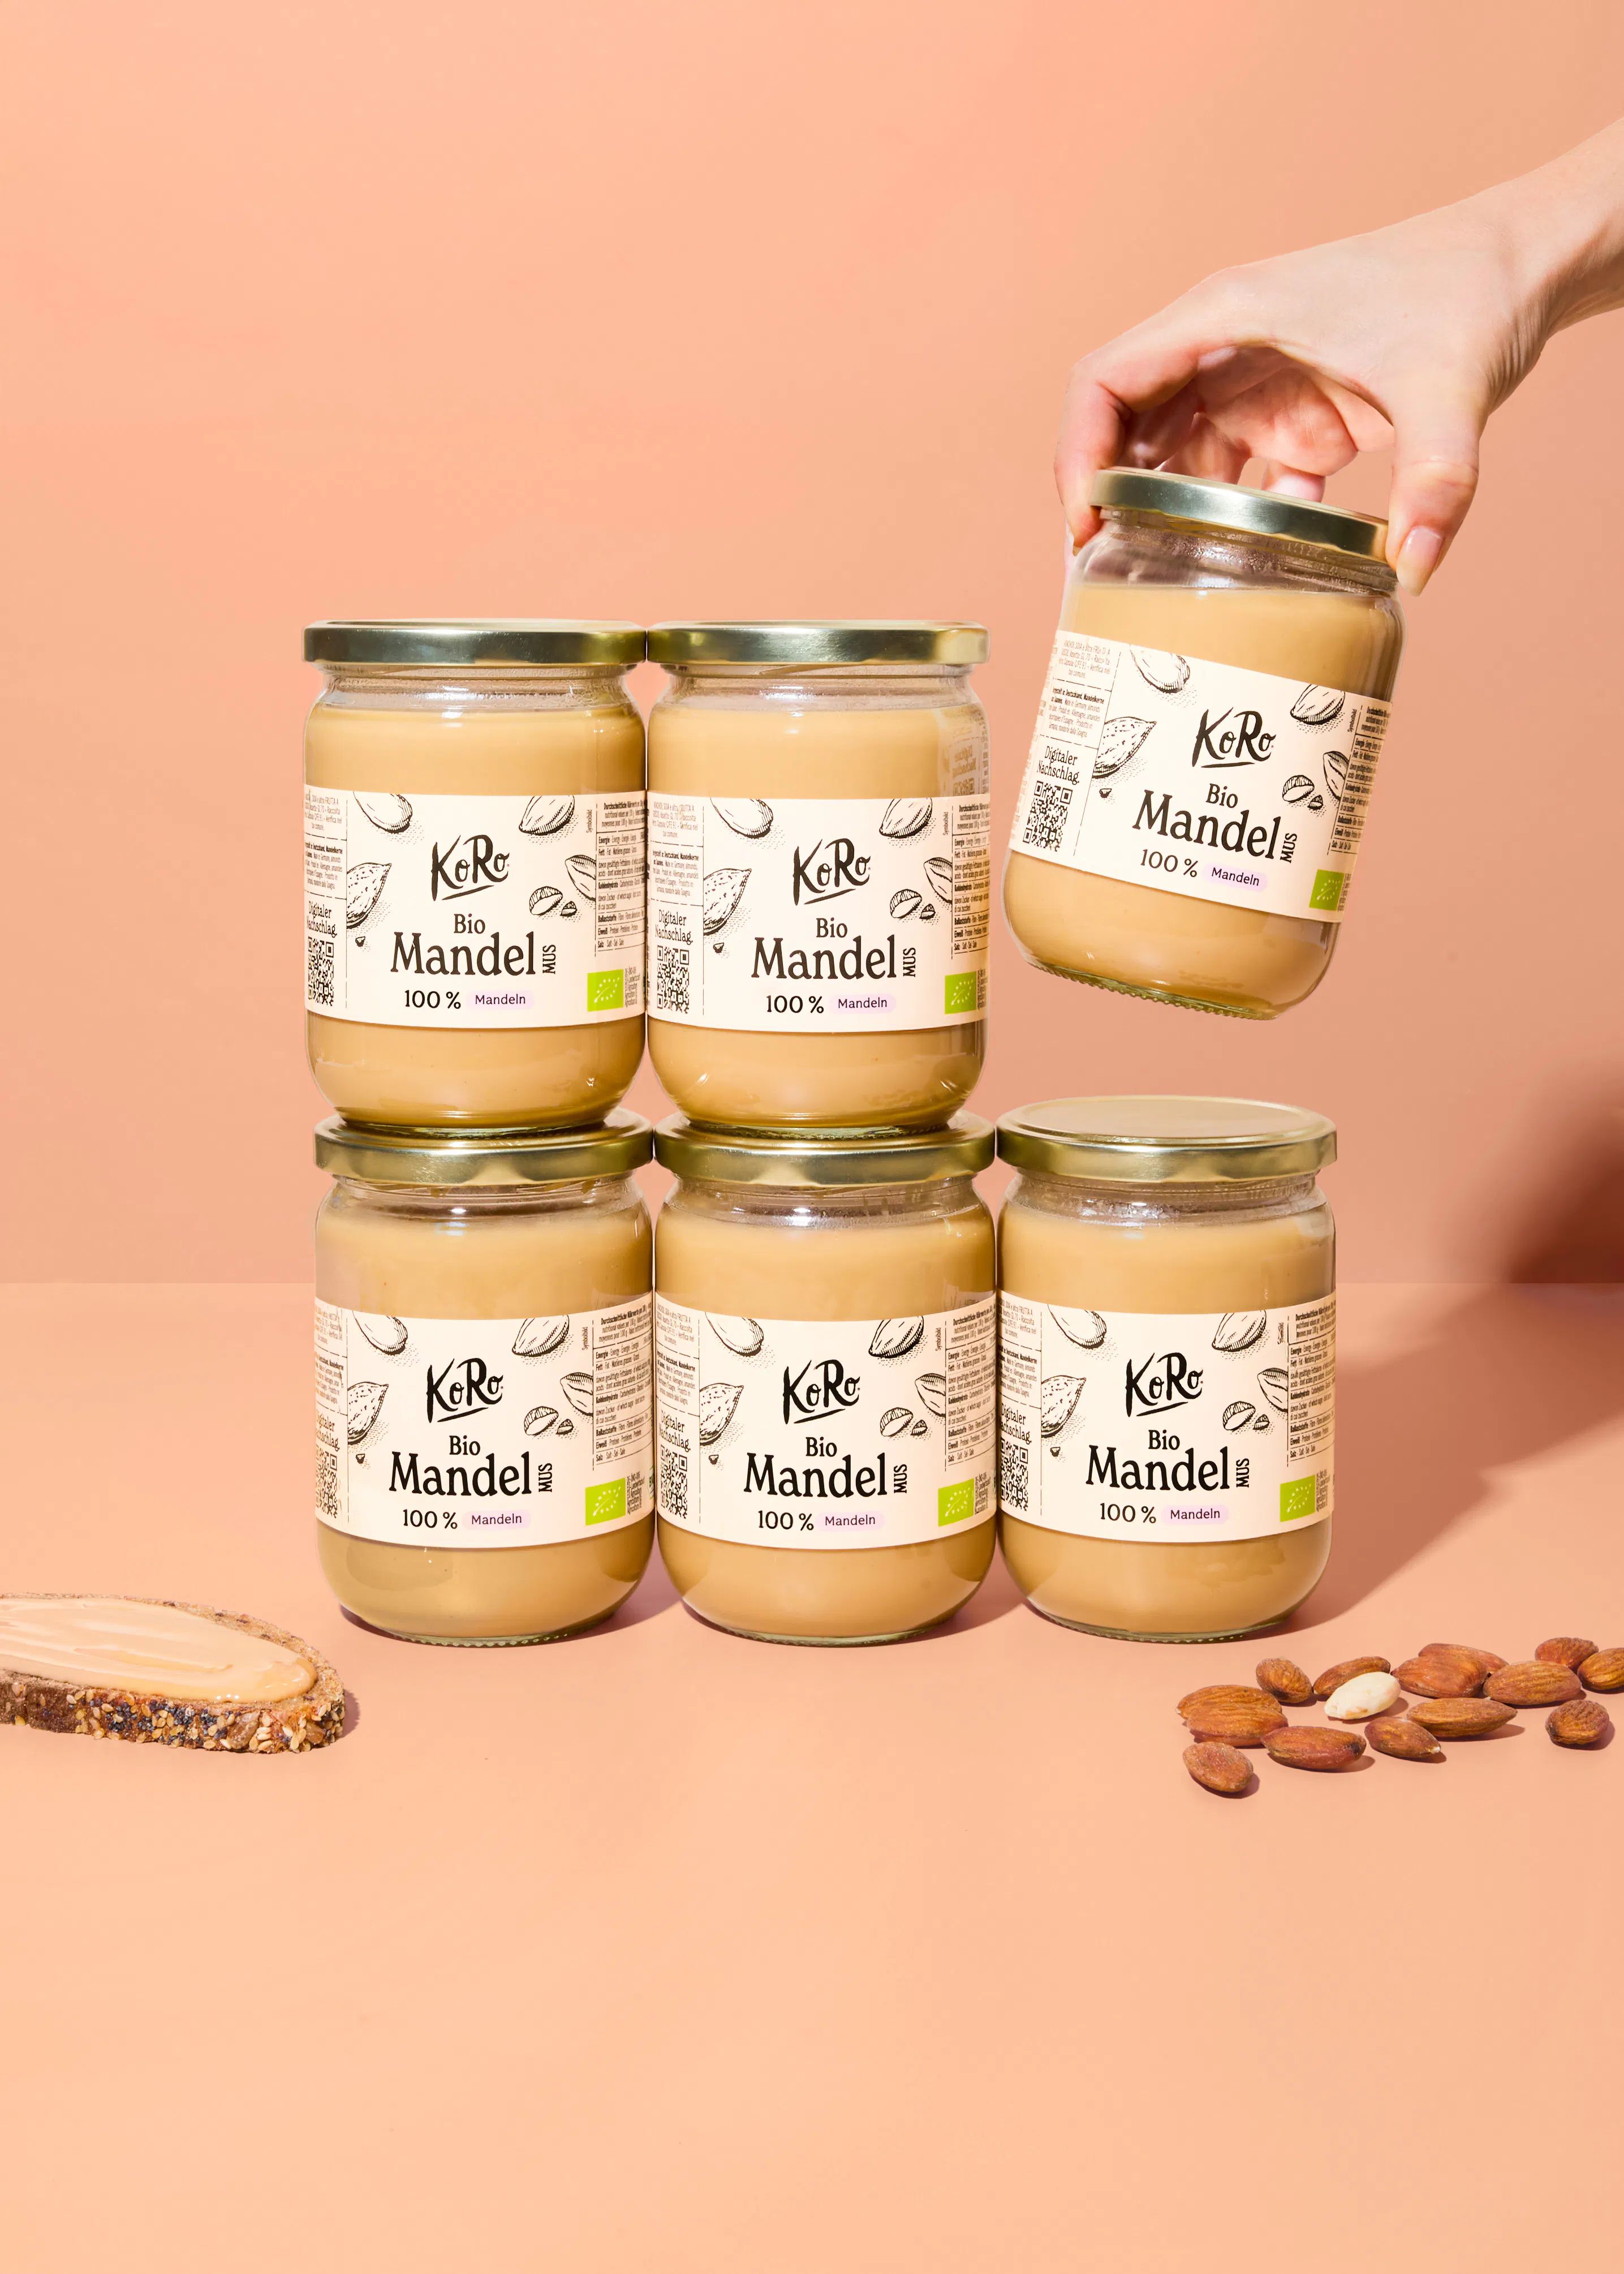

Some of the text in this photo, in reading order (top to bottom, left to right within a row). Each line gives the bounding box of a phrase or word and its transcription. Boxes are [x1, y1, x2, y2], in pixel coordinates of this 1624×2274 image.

[1192, 707, 1276, 768] KoRo
[1045, 746, 1078, 765] Digitaler
[1206, 784, 1238, 808] Bio
[1132, 789, 1281, 859] Mandel
[1280, 833, 1297, 863] MUS
[431, 835, 509, 901] KoRo
[793, 839, 871, 905] KoRo
[1141, 849, 1259, 885] 100 % Mandeln
[309, 900, 331, 918] Digitaler
[659, 909, 687, 926] Digitaler
[454, 914, 485, 934] Bio
[816, 918, 847, 938] Bio
[391, 931, 535, 975] Mandel
[542, 945, 555, 974] MUS
[751, 934, 896, 979] Mandel
[903, 948, 915, 977] MUS
[405, 990, 525, 1009] 100 % Mandeln
[766, 995, 887, 1013] 100 % Mandeln
[427, 1358, 503, 1423] KoRo
[783, 1360, 860, 1424] KoRo
[1125, 1352, 1203, 1417] KoRo
[661, 1409, 684, 1433] Digitaler
[1001, 1403, 1026, 1425] Digitaler
[449, 1435, 480, 1455] Bio
[806, 1437, 837, 1457] Bio
[1148, 1430, 1180, 1450] Bio
[389, 1451, 532, 1497] Mandel
[539, 1463, 552, 1492] MUS
[744, 1452, 887, 1498] Mandel
[894, 1464, 907, 1493] MUS
[1086, 1446, 1230, 1491] Mandel
[1236, 1459, 1249, 1488] MUS
[403, 1509, 522, 1529] 100 % Mandeln
[759, 1511, 875, 1531] 100 % Mandeln
[1100, 1503, 1220, 1523] 100 % Mandeln
